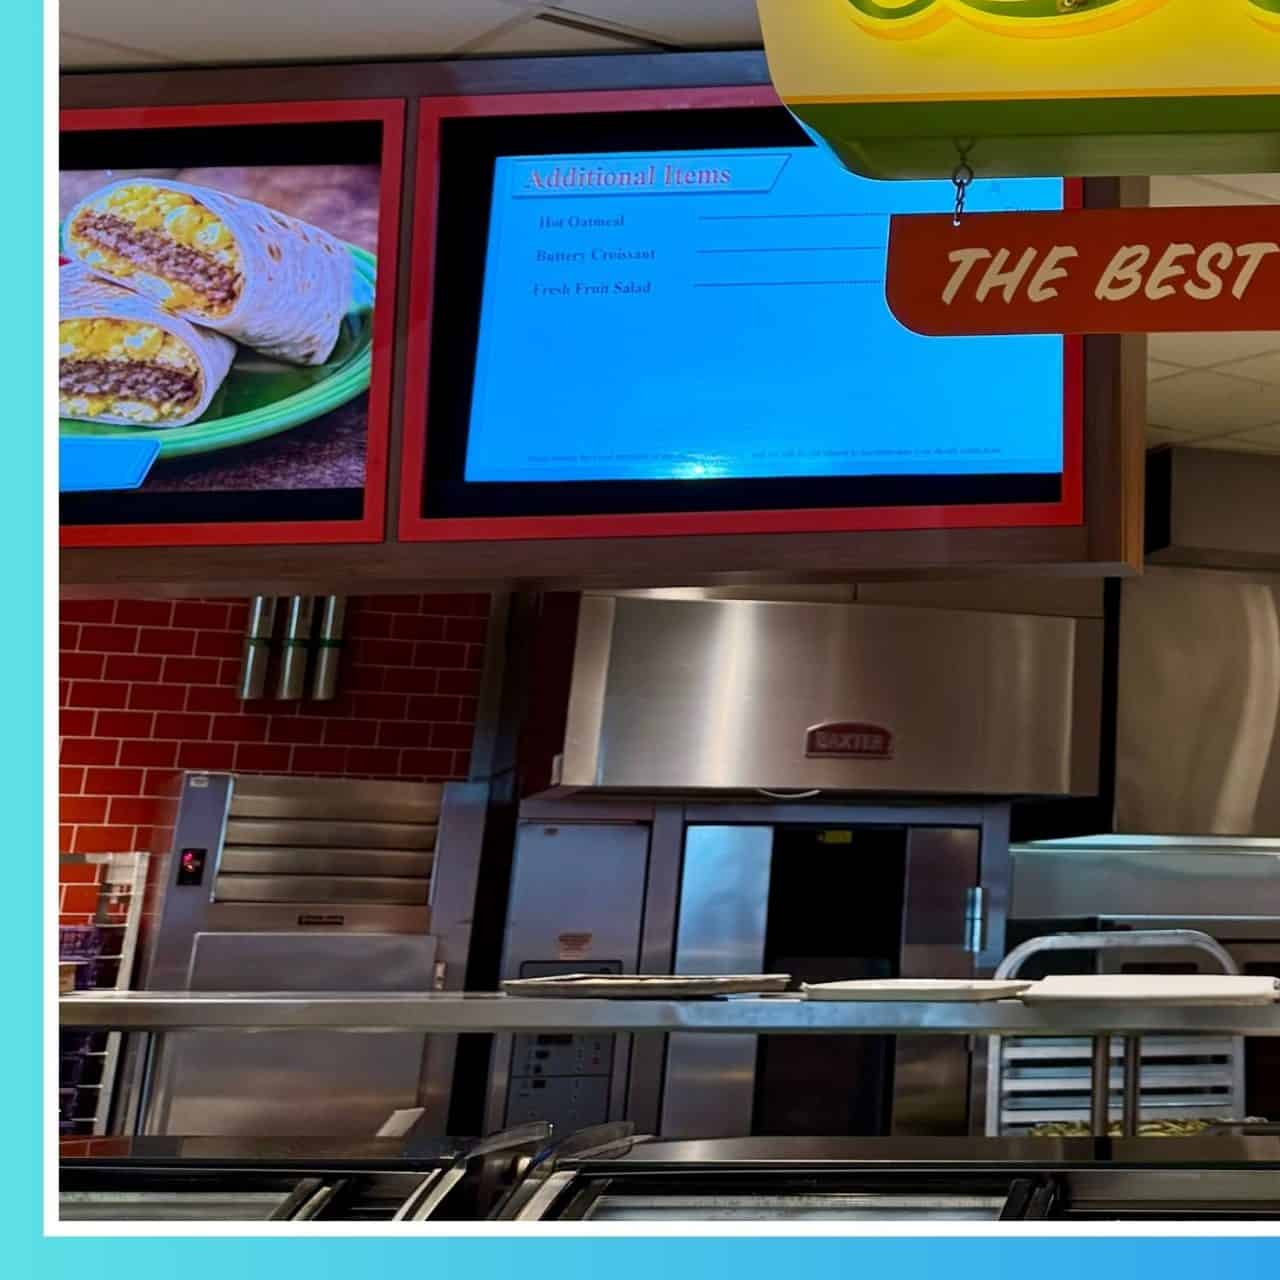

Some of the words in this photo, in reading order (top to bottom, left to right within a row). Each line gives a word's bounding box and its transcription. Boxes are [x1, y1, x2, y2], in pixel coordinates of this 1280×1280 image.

[525, 165, 655, 191] Additional
[663, 163, 732, 186] Items
[568, 215, 625, 229] Oatmeal
[536, 249, 586, 265] Buttery
[591, 247, 656, 262] Croissant
[940, 245, 1080, 306] THE
[1093, 241, 1280, 302] BEST
[533, 282, 570, 297] Fresh
[614, 279, 652, 294] Salad
